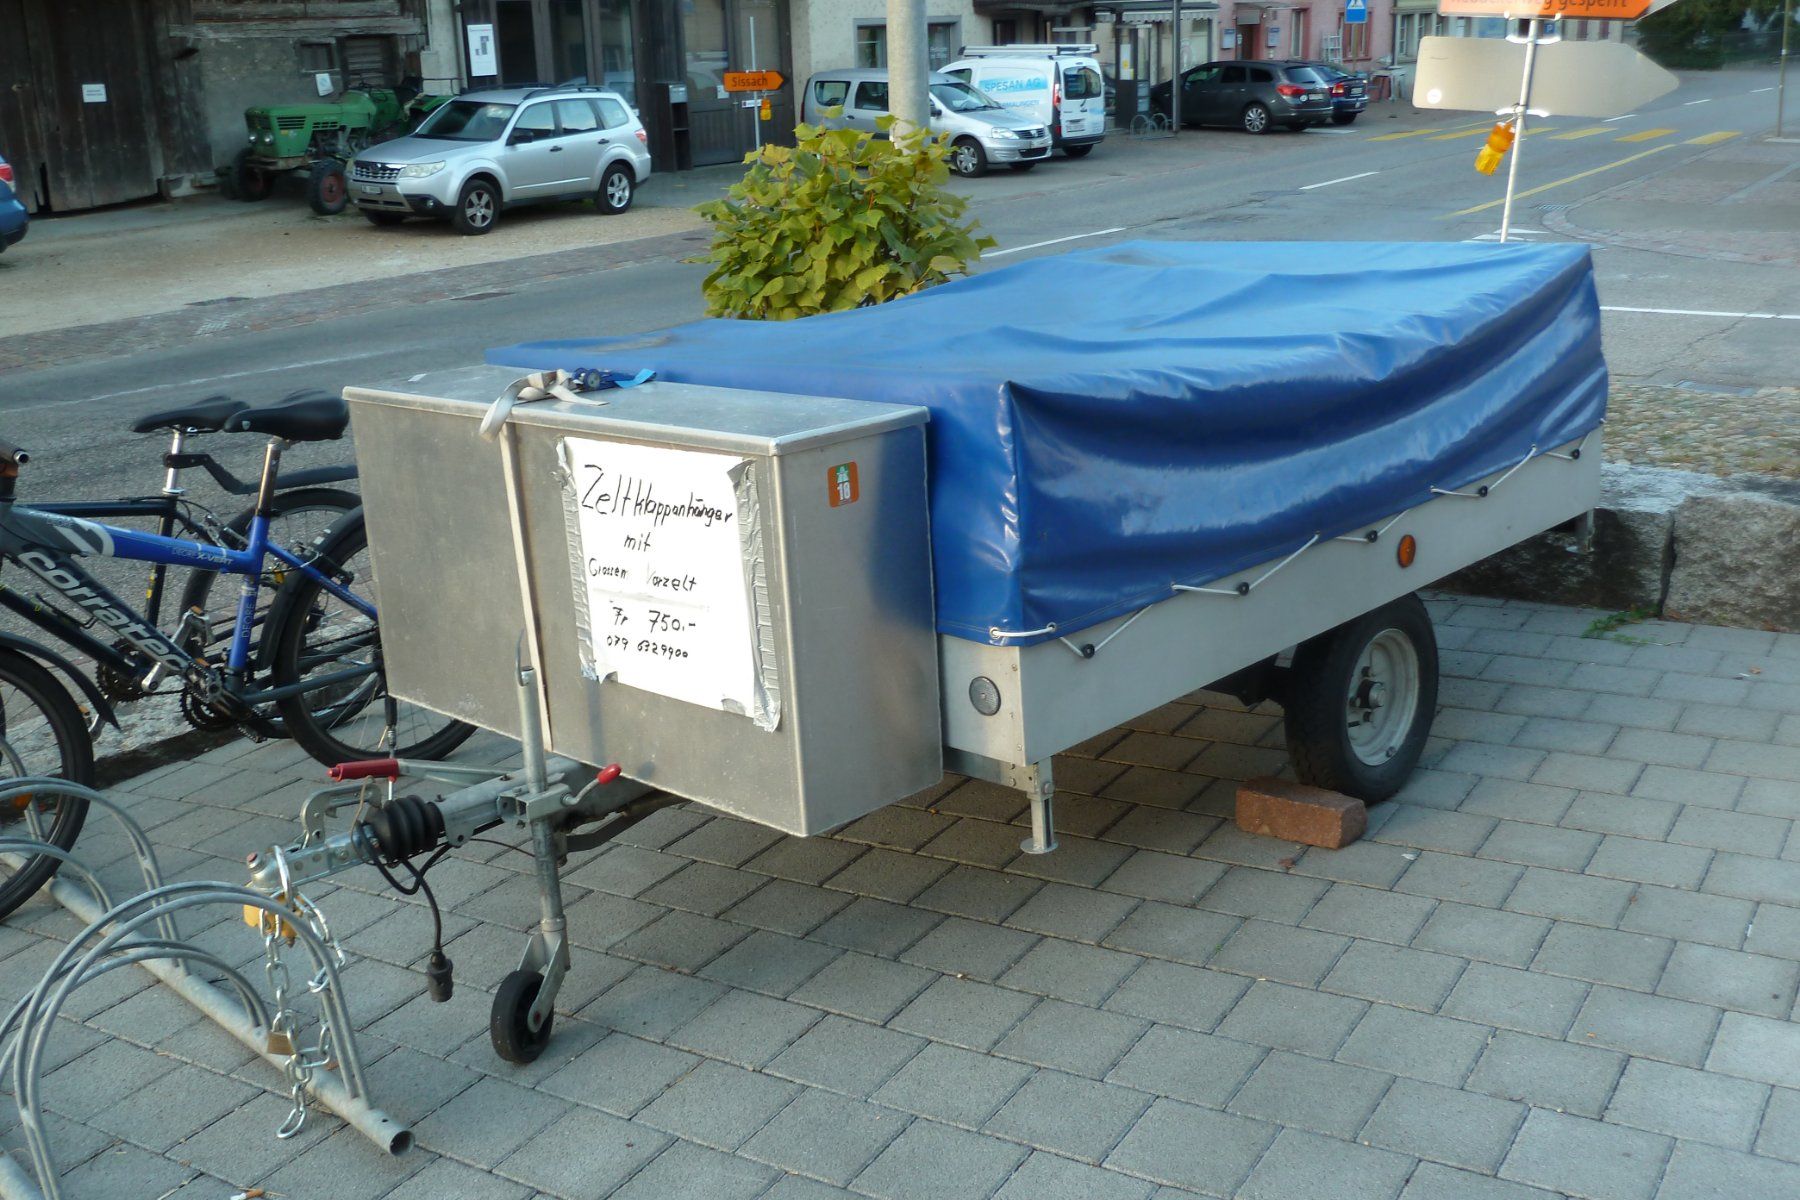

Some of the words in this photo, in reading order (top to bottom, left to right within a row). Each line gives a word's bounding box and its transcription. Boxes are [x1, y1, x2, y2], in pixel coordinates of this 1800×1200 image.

[731, 76, 768, 87] Sissach
[984, 79, 1022, 92] SPESAN
[1025, 77, 1040, 89] AG
[624, 531, 651, 552] mit
[648, 610, 696, 633] 750.-
[606, 635, 629, 651] 079
